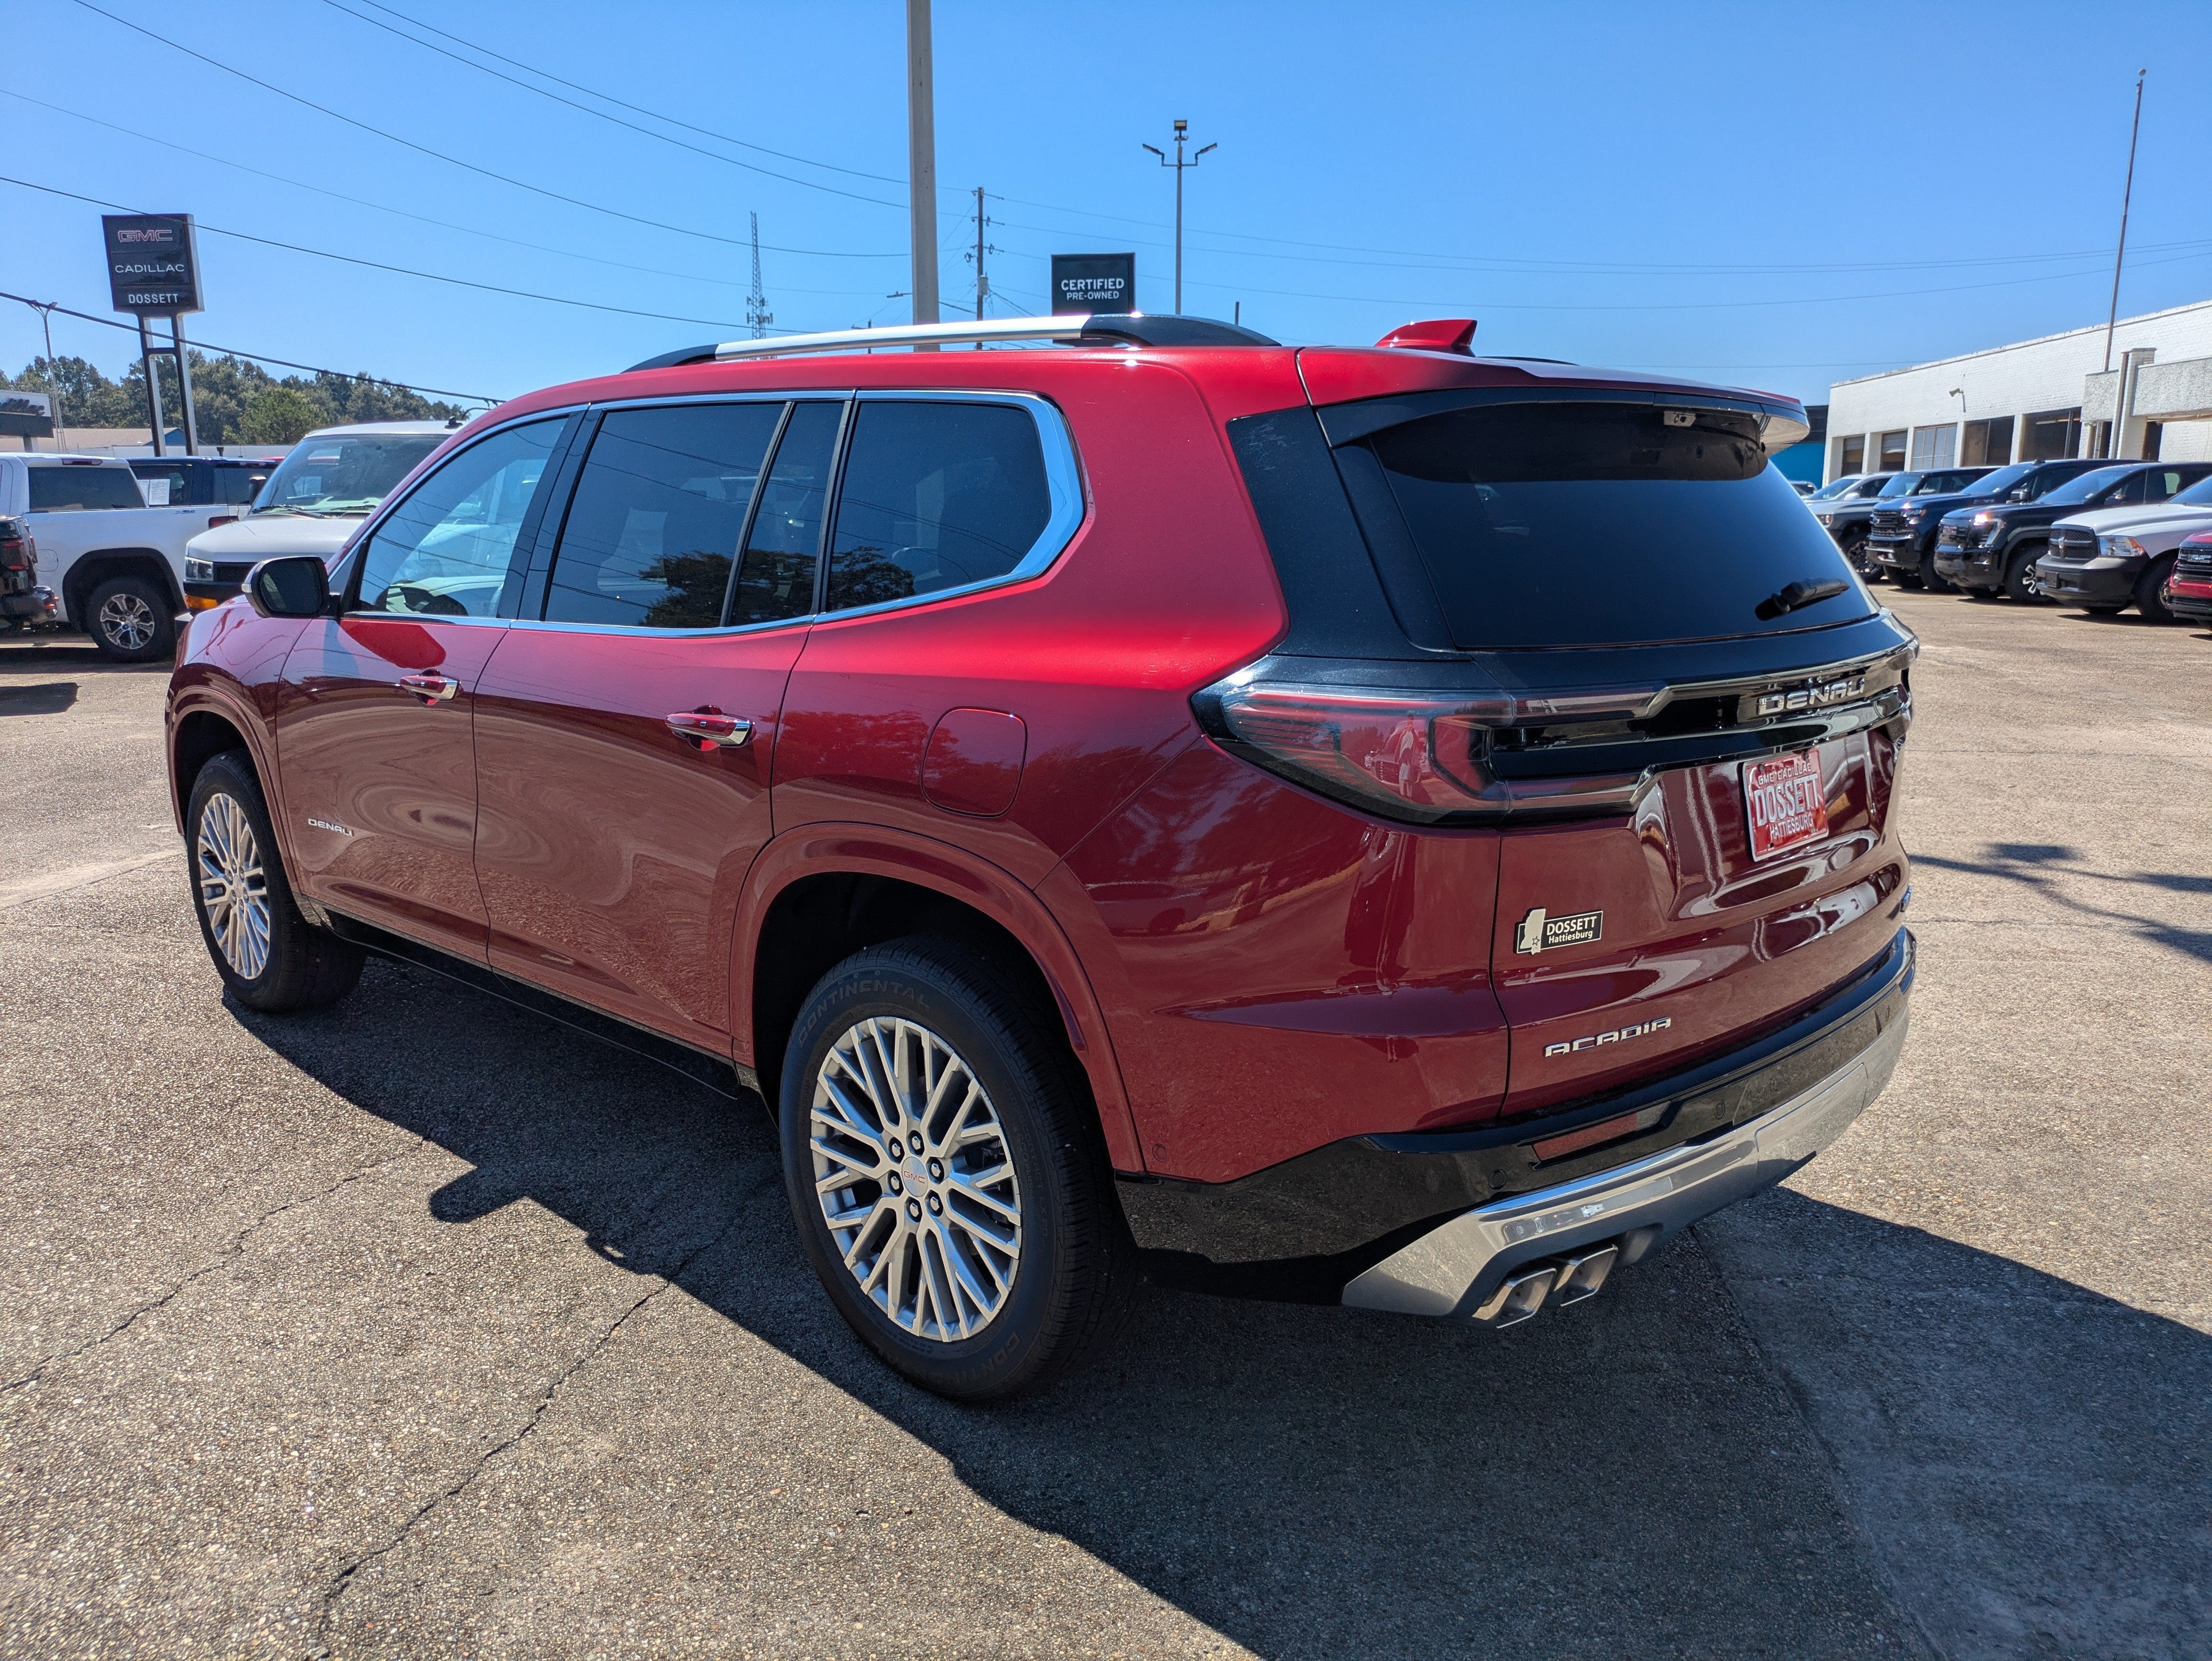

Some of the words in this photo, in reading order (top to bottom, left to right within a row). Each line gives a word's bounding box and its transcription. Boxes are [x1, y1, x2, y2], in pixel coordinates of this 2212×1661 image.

[118, 230, 173, 243] GMC
[115, 264, 185, 273] CADILLAC
[1061, 278, 1124, 290] CERTIFIED
[128, 294, 178, 304] DOSSETT
[1066, 291, 1119, 300] PRE-OWNED
[1758, 678, 1865, 715] DENALI
[1754, 773, 1818, 827] DOSSETT
[308, 818, 354, 837] DENALI
[1770, 813, 1814, 841] HATTIESBURG
[1546, 916, 1597, 936] DOSSETT
[1548, 930, 1593, 944] Hattiesburg
[798, 980, 931, 1048] CONTINENTAL
[1545, 1017, 1671, 1057] ACADIA
[904, 1171, 925, 1184] GMC
